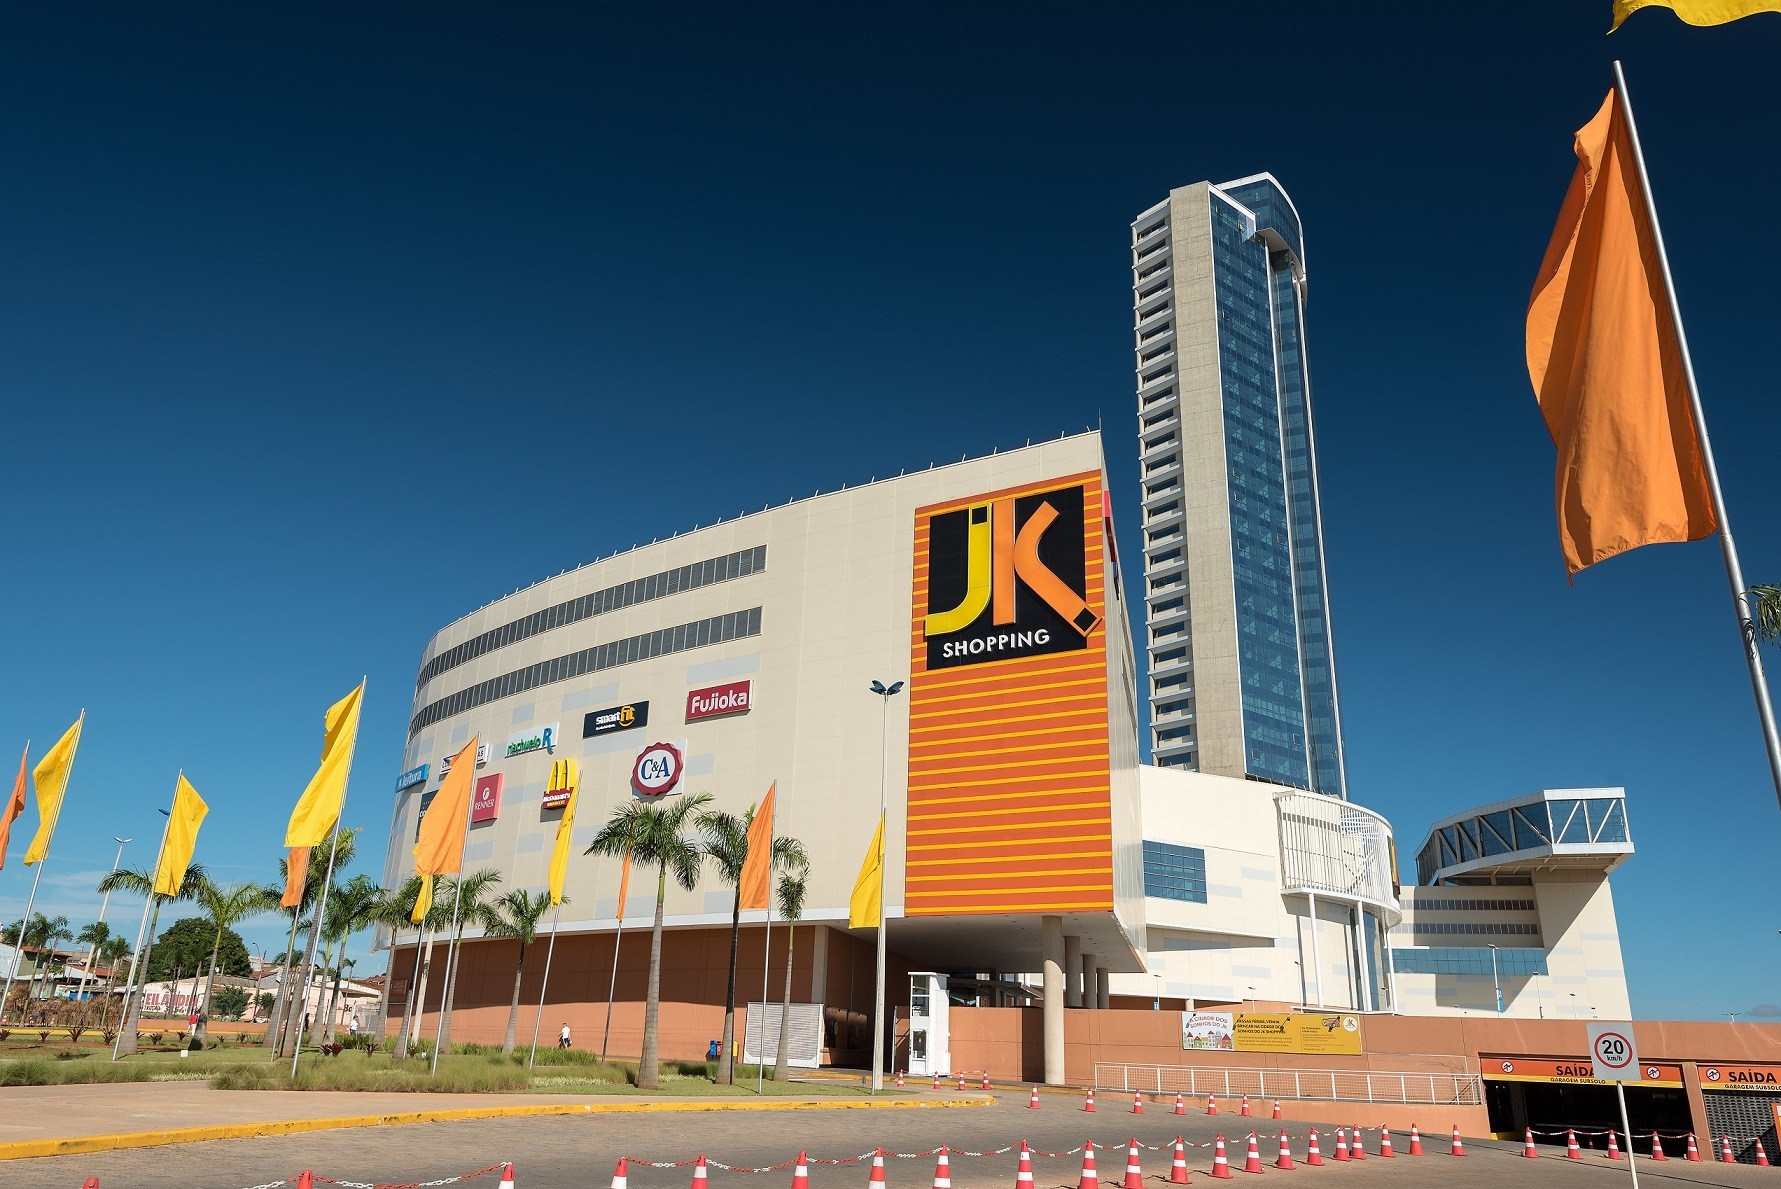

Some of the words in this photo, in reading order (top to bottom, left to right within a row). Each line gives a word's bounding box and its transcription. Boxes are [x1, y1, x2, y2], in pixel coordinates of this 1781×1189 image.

[925, 497, 1103, 638] JK
[942, 628, 1050, 658] SHOPPING
[691, 689, 748, 714] Fujioka
[640, 756, 671, 780] C&A
[474, 798, 495, 811] RENNER
[1215, 1016, 1228, 1024] DOS
[1602, 1039, 1624, 1055] 20
[1606, 1054, 1623, 1062] km/h
[1728, 1068, 1778, 1084] SAÍDA
